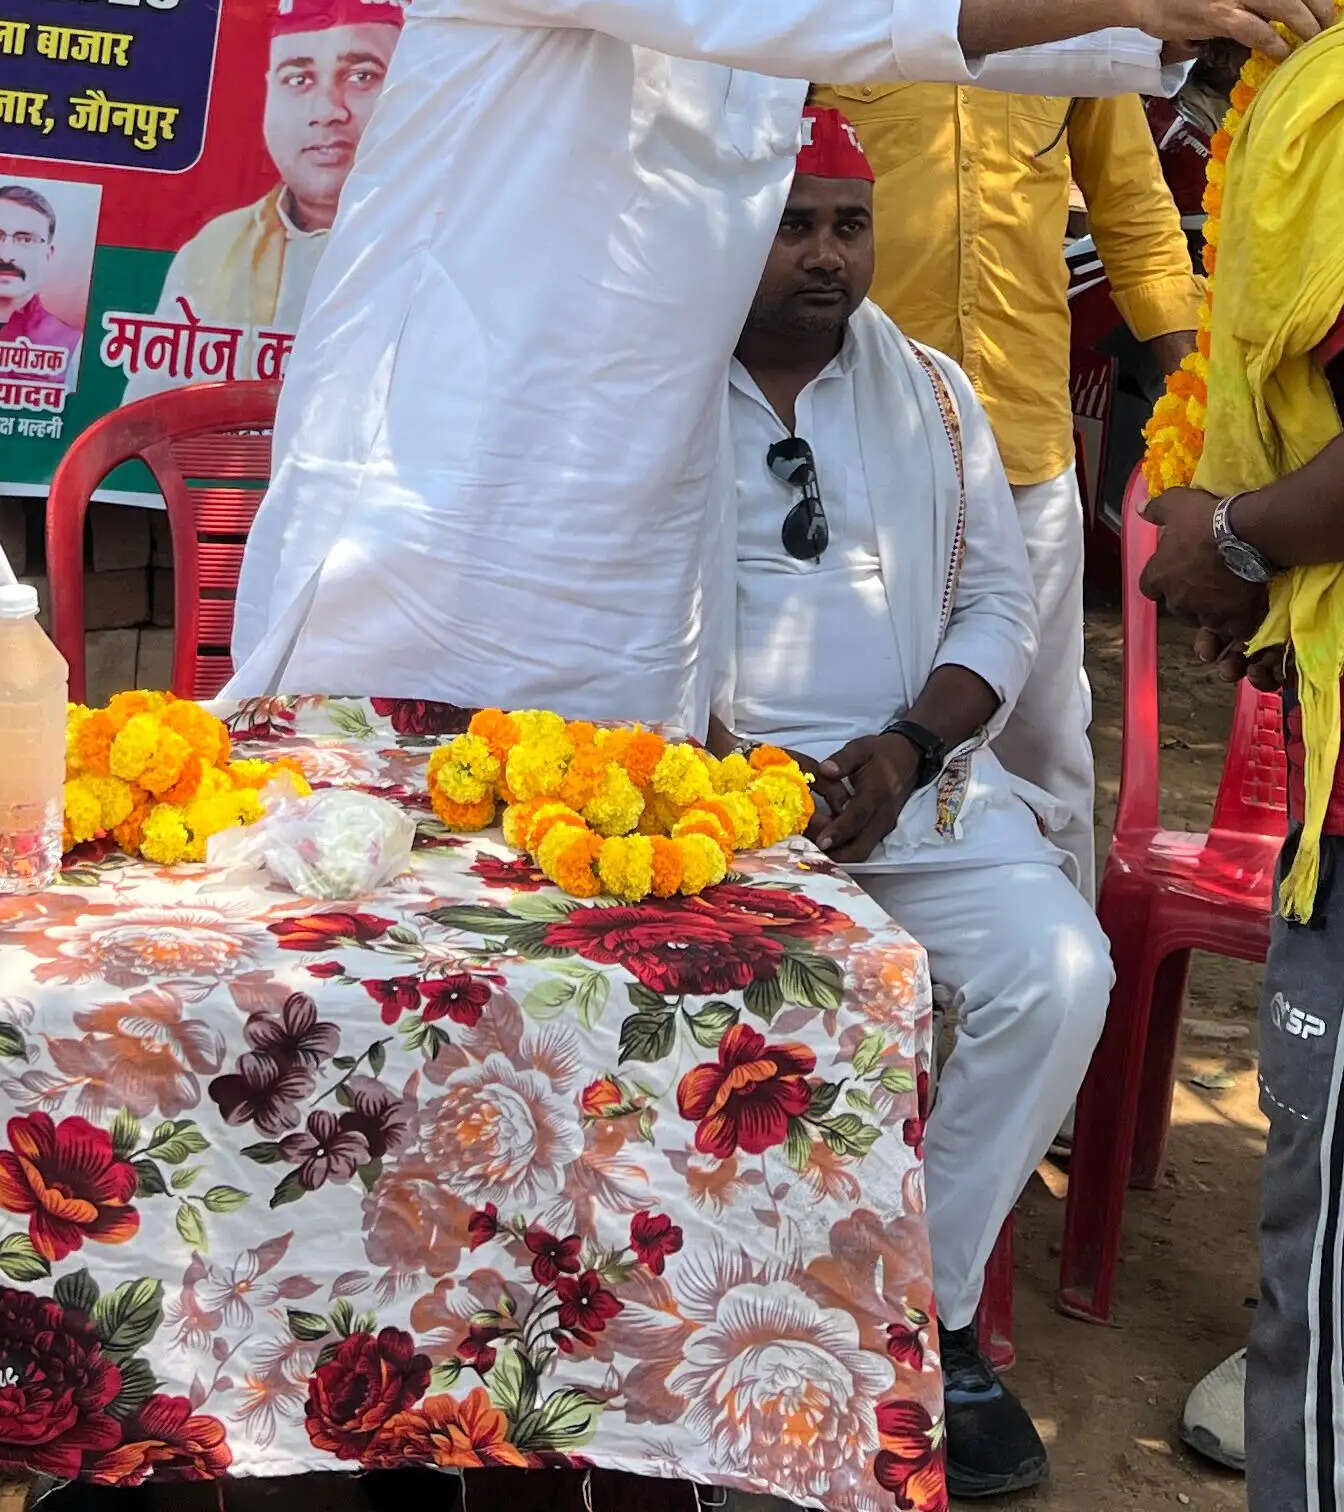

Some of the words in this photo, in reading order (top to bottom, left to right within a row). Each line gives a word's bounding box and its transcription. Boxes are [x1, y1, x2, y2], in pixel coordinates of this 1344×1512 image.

[36, 24, 134, 67] बाजार
[68, 88, 180, 151] जौनपुर
[106, 295, 244, 381] मनोज
